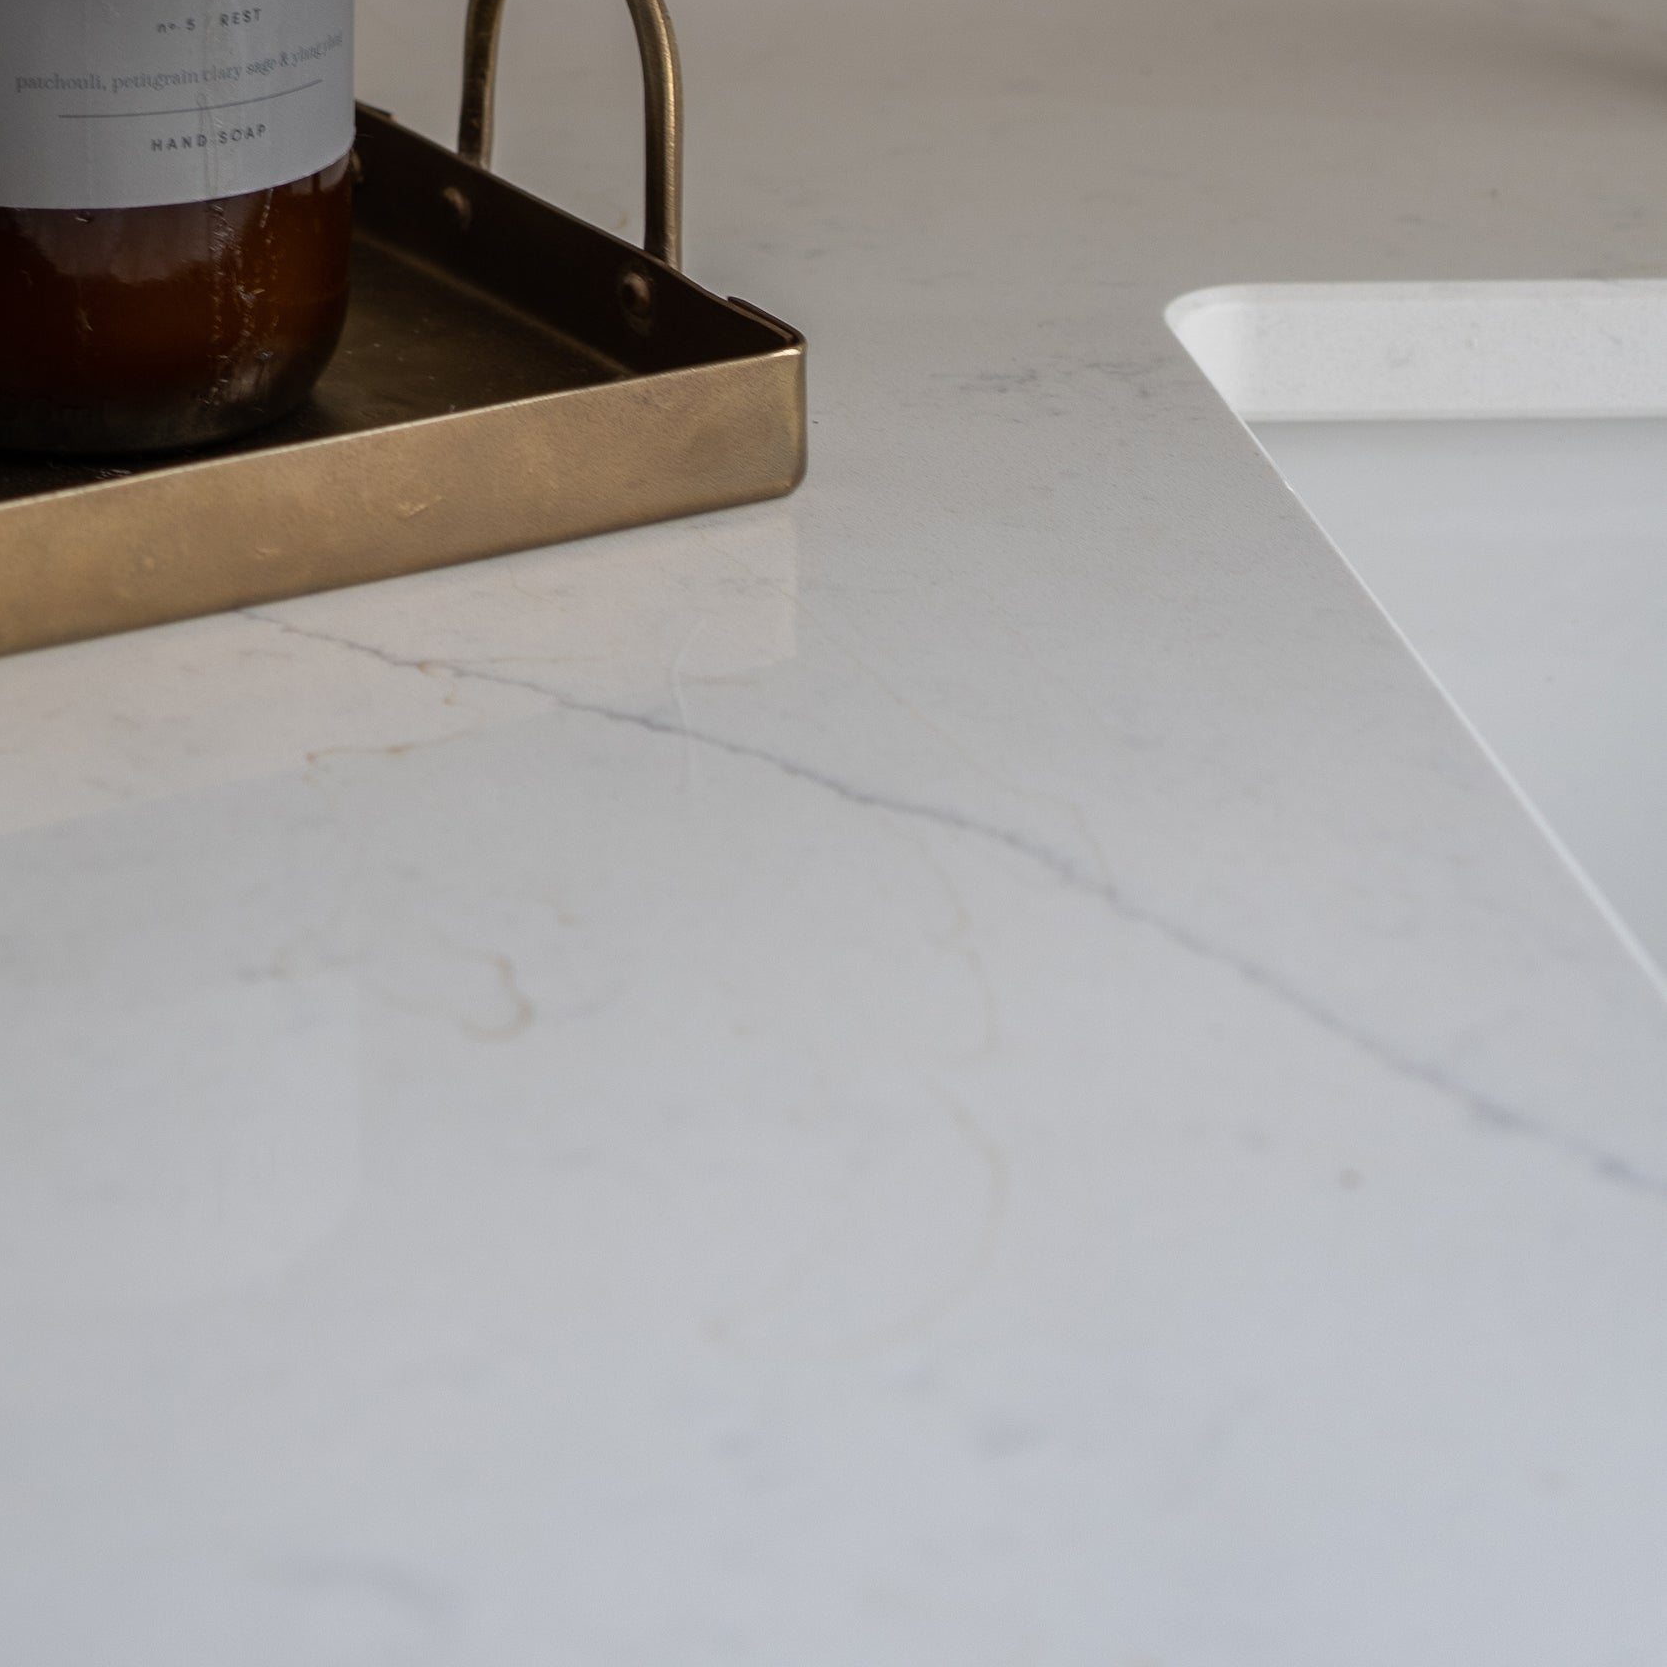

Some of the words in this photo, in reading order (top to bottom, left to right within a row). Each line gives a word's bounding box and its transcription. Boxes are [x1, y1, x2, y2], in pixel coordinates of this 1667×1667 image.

[219, 7, 262, 27] REST
[14, 72, 108, 94] patchouli,
[150, 133, 208, 152] HAND
[218, 123, 267, 145] SOAP
